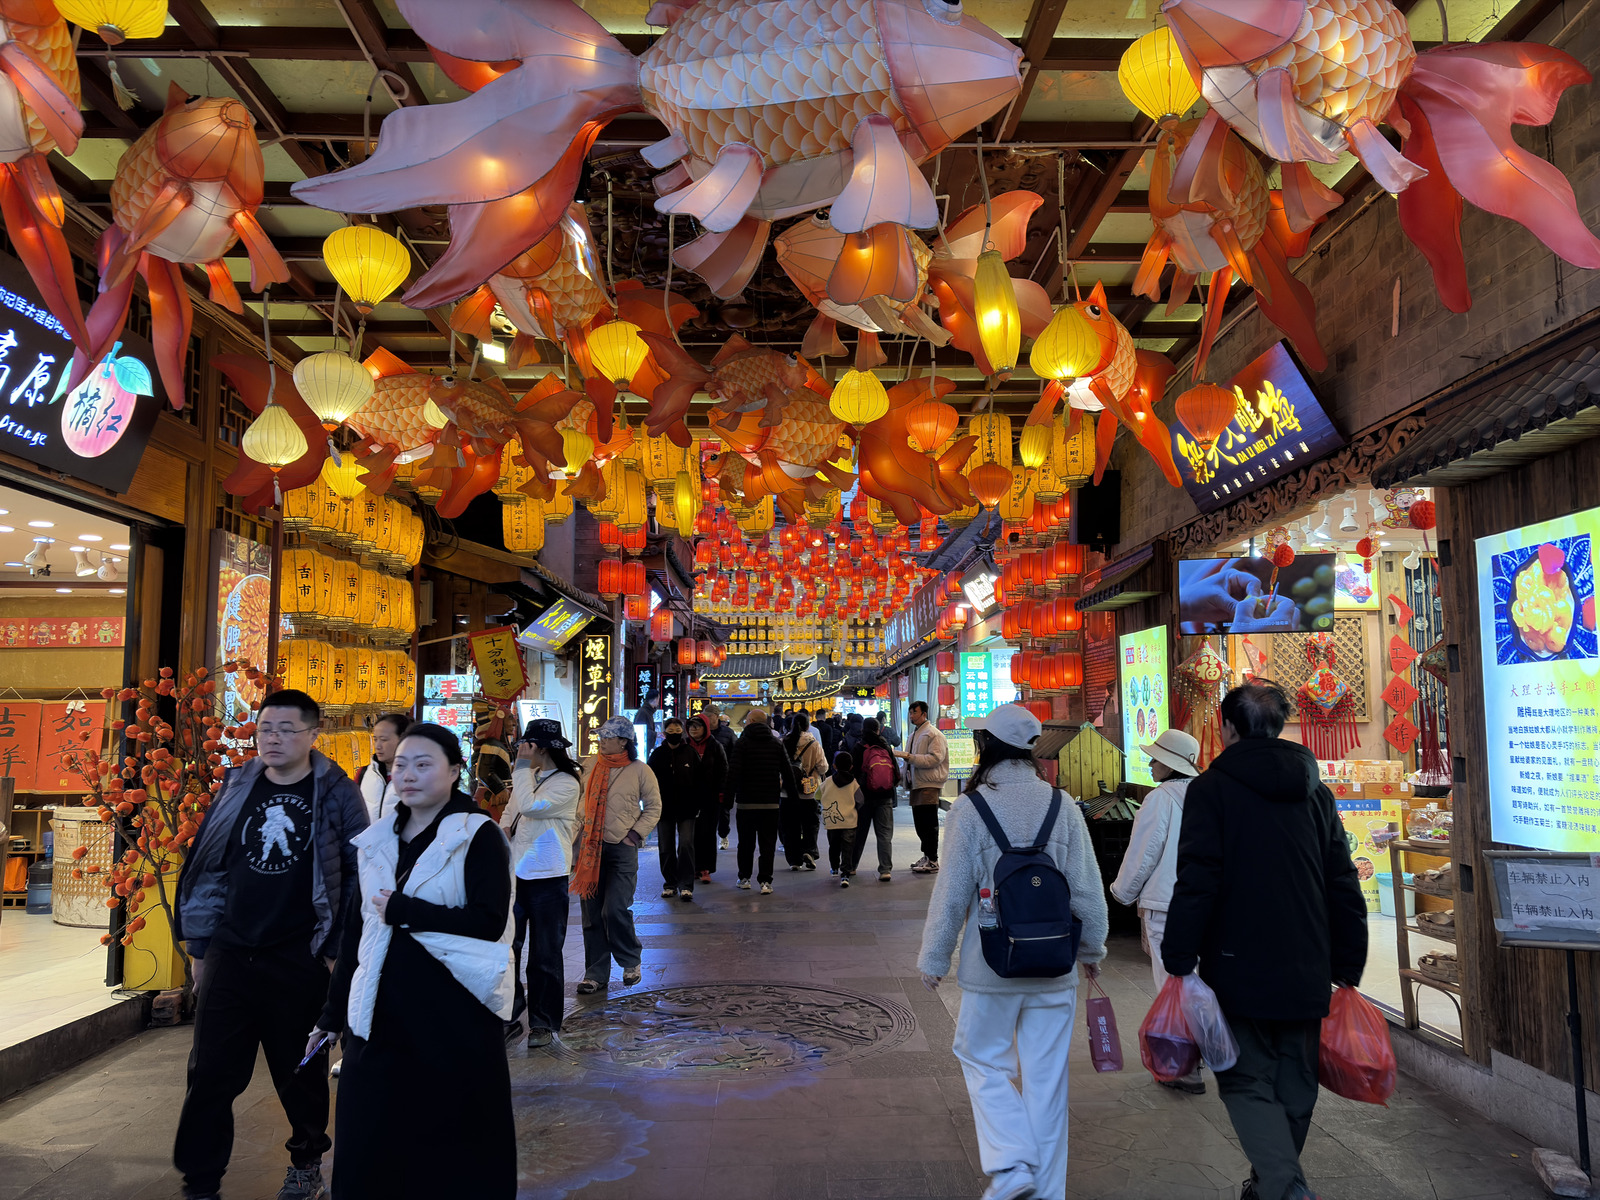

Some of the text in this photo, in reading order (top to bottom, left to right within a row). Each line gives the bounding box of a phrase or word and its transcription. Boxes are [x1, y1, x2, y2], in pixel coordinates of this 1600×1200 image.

[1236, 450, 1250, 464] DA
[364, 502, 377, 528] 吉市
[297, 567, 312, 598] 吉市
[346, 577, 358, 605] 吉市
[308, 658, 319, 687] 吉市
[333, 663, 345, 691] 吉市
[358, 664, 370, 691] 吉市
[377, 665, 388, 691] 吉市
[397, 664, 407, 690] 吉市
[1194, 655, 1220, 682] 福
[438, 679, 459, 727] 手鼓
[965, 671, 976, 712] 云南最佳
[246, 851, 299, 871] SATELLITE
[1509, 870, 1590, 887] 车辆禁止入内
[1512, 902, 1594, 920] 车辆禁止入内
